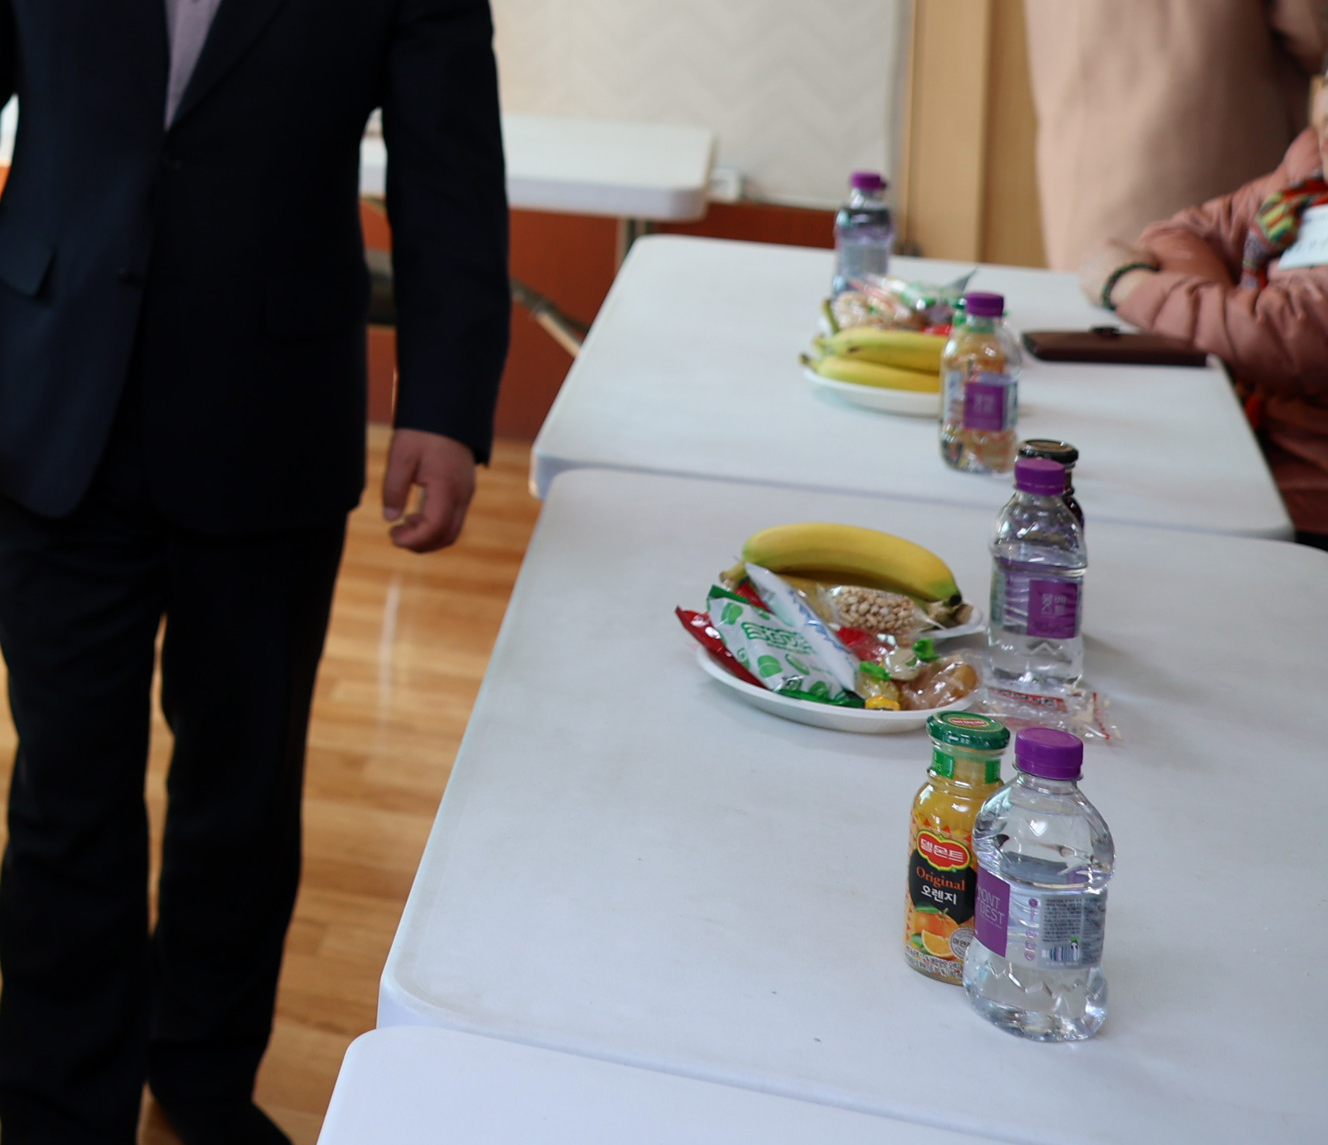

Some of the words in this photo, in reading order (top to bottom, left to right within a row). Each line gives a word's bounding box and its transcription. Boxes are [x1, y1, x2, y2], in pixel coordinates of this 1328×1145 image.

[920, 838, 964, 863] 델몬트
[916, 866, 966, 892] Original
[920, 885, 957, 905] 오렌지
